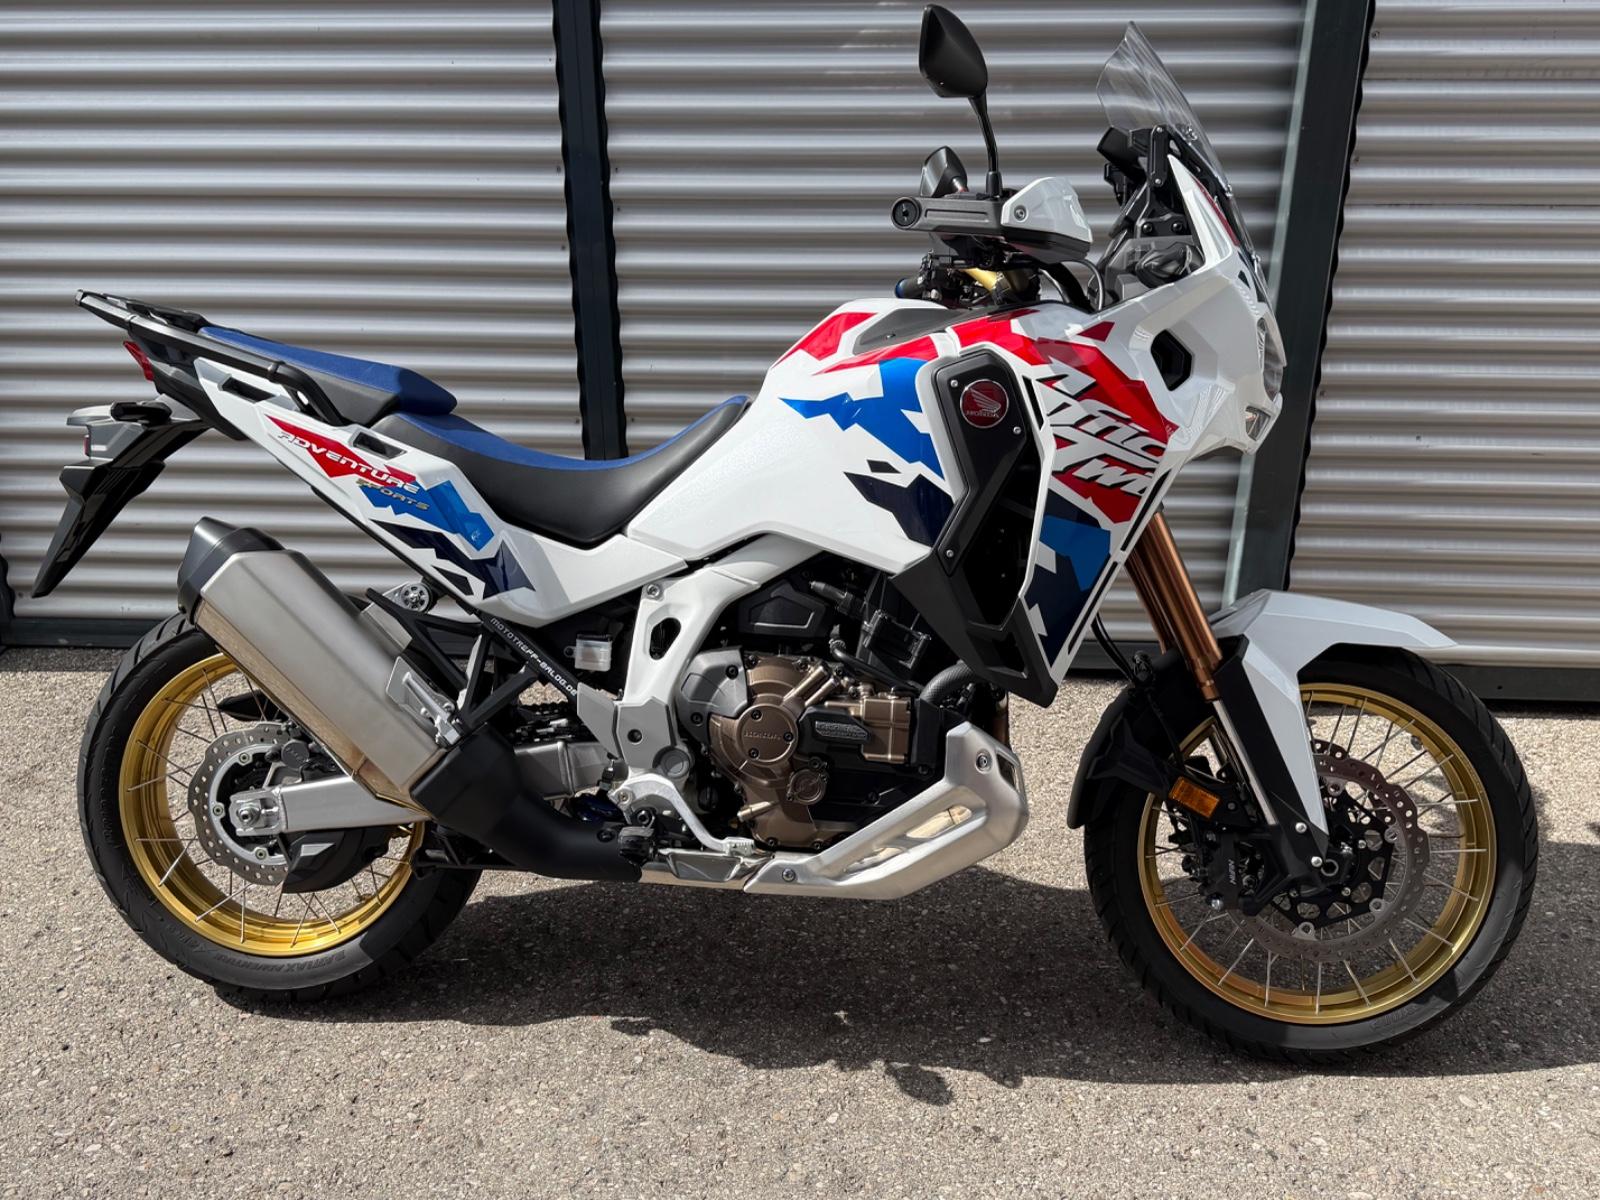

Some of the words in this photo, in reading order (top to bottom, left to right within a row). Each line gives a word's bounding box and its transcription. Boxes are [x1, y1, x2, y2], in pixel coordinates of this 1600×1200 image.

[966, 409, 1000, 418] HONDA
[278, 433, 420, 495] ADVENTURE
[355, 478, 430, 511] SPORTS
